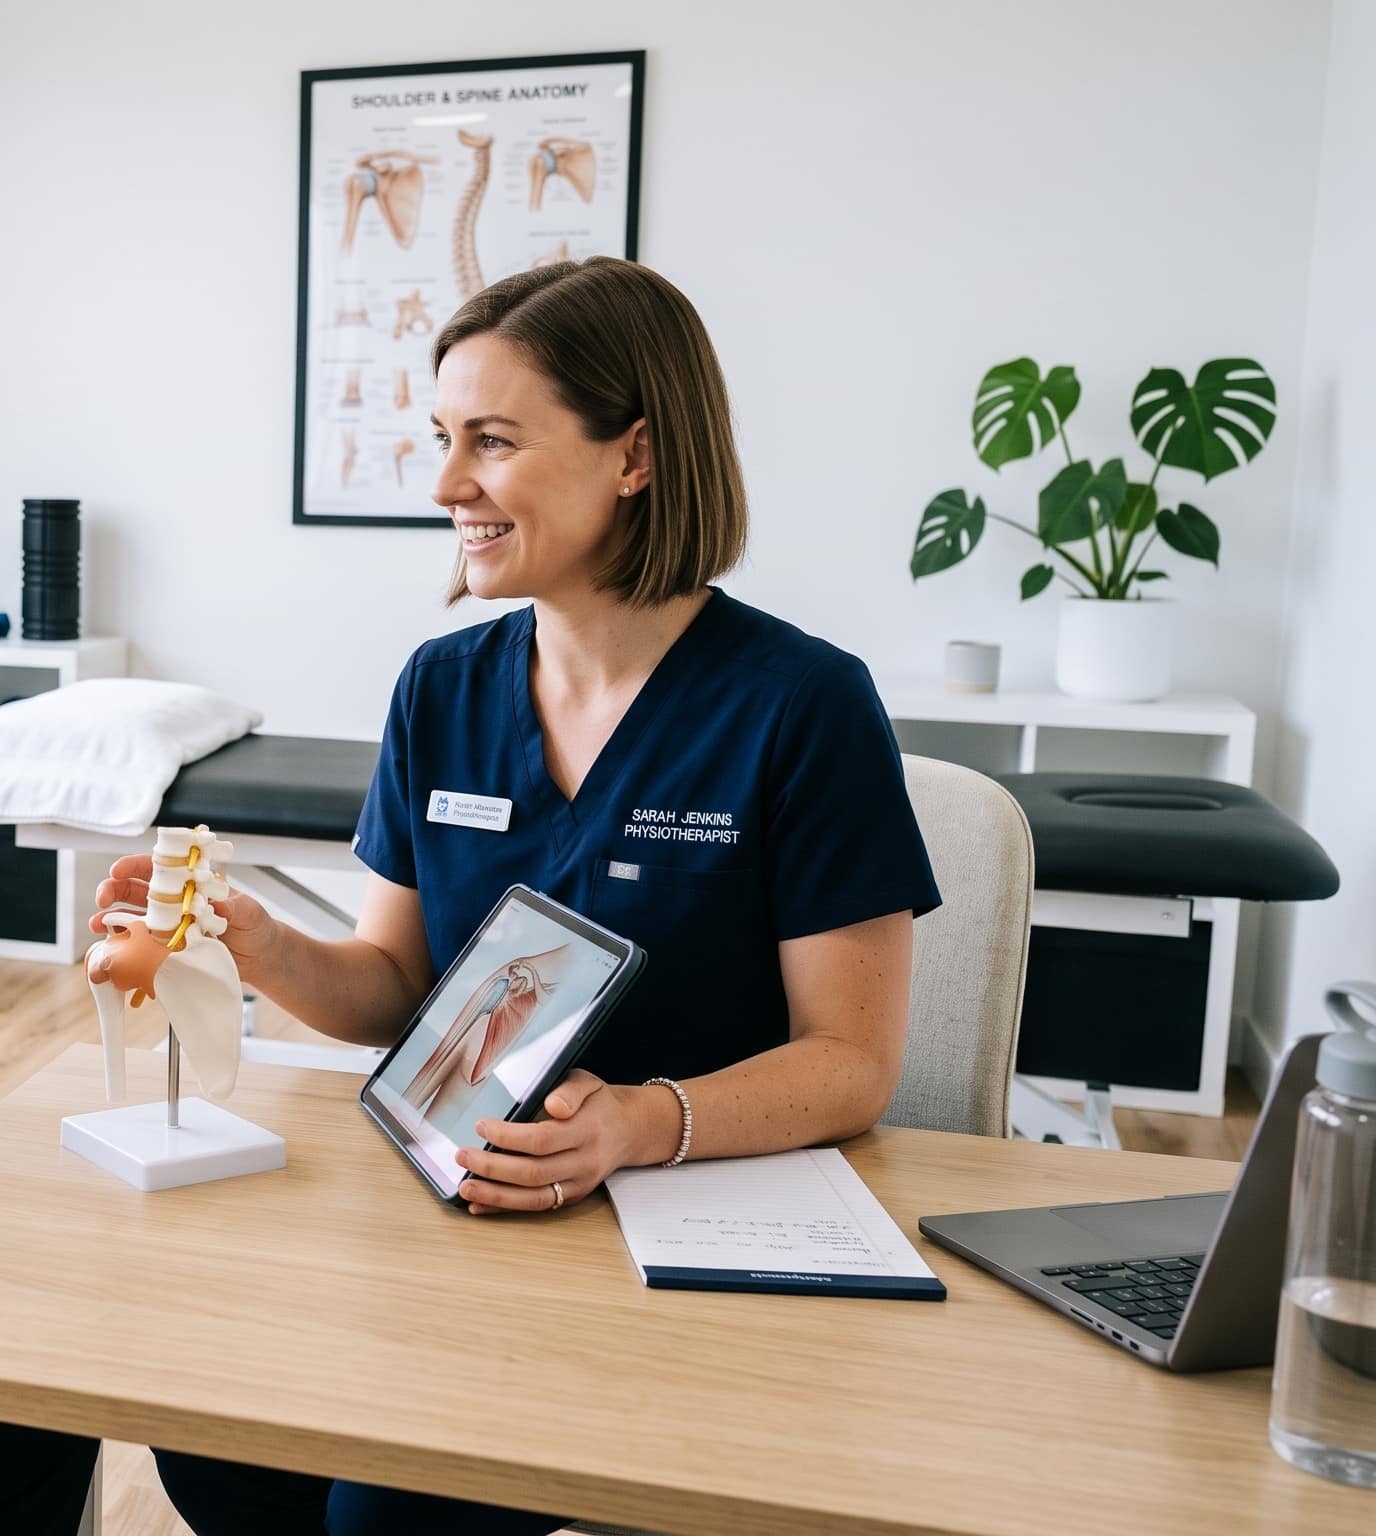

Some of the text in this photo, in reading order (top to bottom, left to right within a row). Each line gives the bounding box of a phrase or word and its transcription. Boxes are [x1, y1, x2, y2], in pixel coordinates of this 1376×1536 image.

[351, 83, 589, 109] SHOULDER & SPINE ANATOMY
[632, 809, 733, 826] SARAH JENKINS
[624, 824, 741, 844] PHYSIOTHERAPIST
